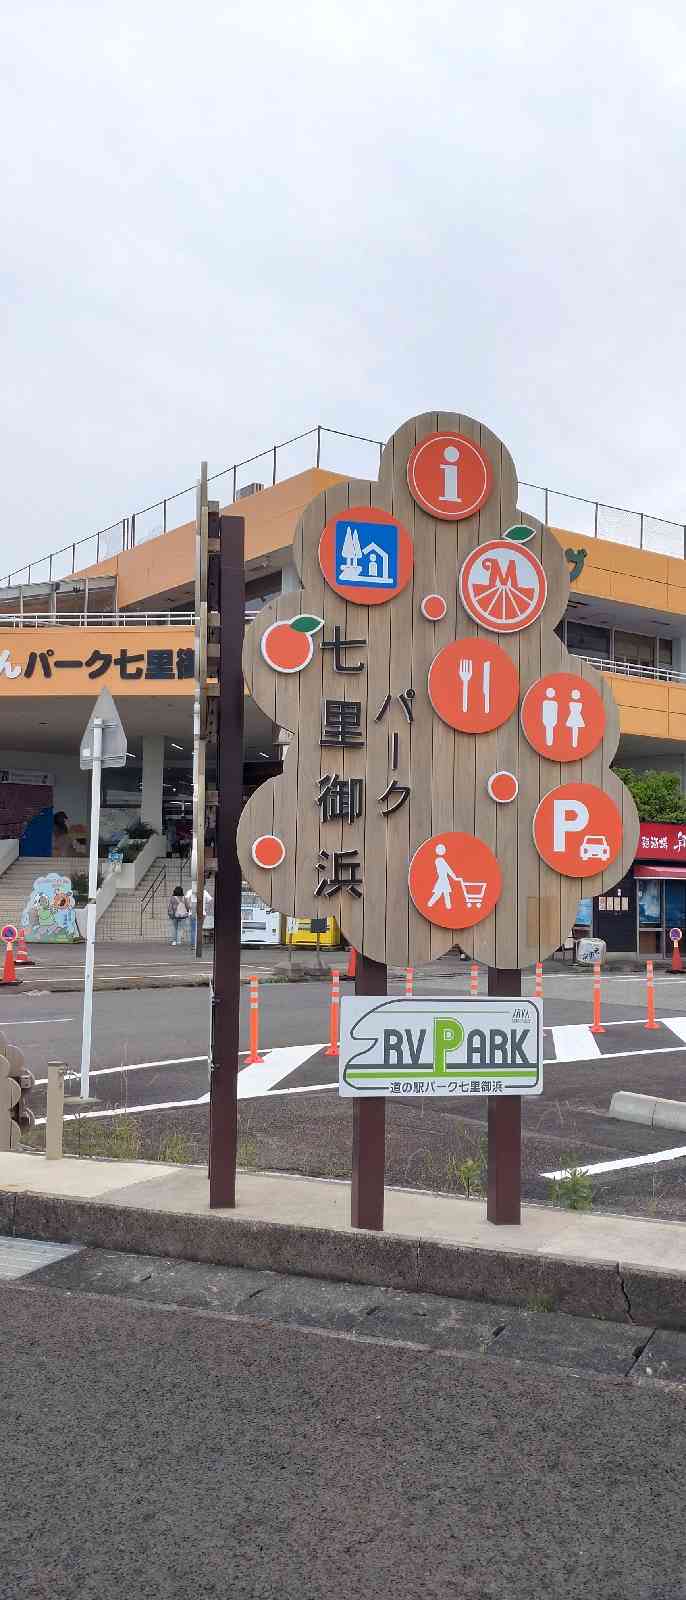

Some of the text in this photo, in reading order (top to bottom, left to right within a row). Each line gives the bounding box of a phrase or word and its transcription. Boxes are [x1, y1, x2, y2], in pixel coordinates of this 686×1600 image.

[314, 625, 367, 897] 七里御浜
[374, 688, 415, 816] パーク
[553, 799, 590, 852] P
[383, 1016, 531, 1072] RV PARK
[390, 1080, 503, 1093] 道の駅パーク七里御浜
